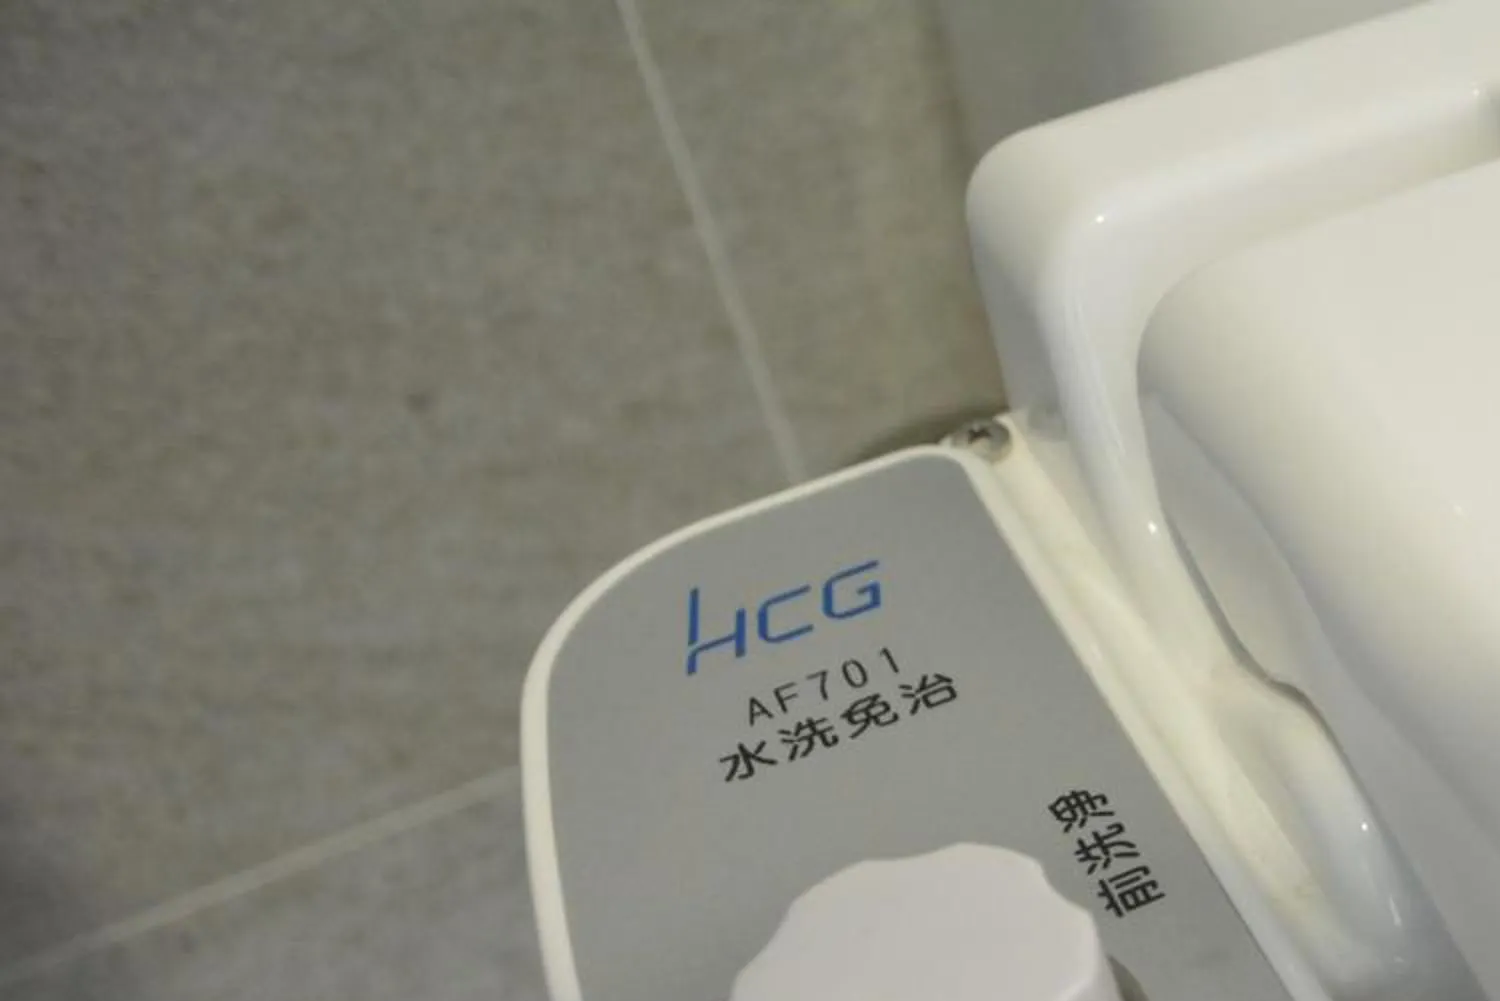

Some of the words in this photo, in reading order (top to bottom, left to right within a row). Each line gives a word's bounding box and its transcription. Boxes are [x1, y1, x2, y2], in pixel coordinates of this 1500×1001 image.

[686, 560, 882, 676] HCG
[718, 672, 958, 783] 水洗免治
[747, 647, 900, 725] AF701
[1047, 788, 1165, 918] 前洗淨
